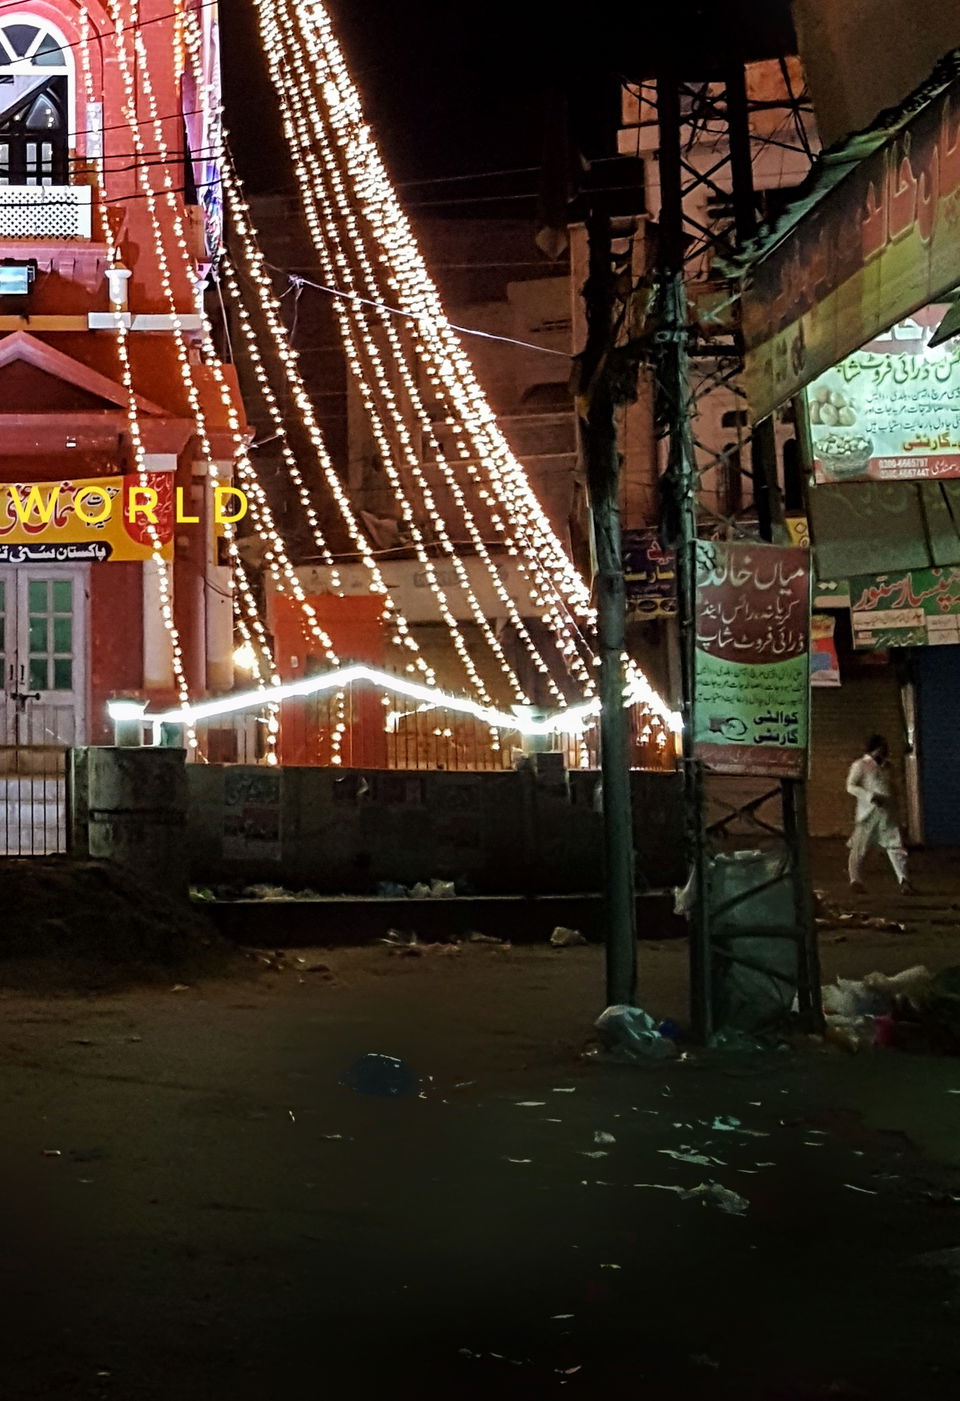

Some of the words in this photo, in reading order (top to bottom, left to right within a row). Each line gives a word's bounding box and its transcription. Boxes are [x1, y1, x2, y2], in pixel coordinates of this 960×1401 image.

[859, 354, 893, 386] فروٹ
[56, 543, 107, 562] پاکستان
[753, 560, 805, 596] میاں
